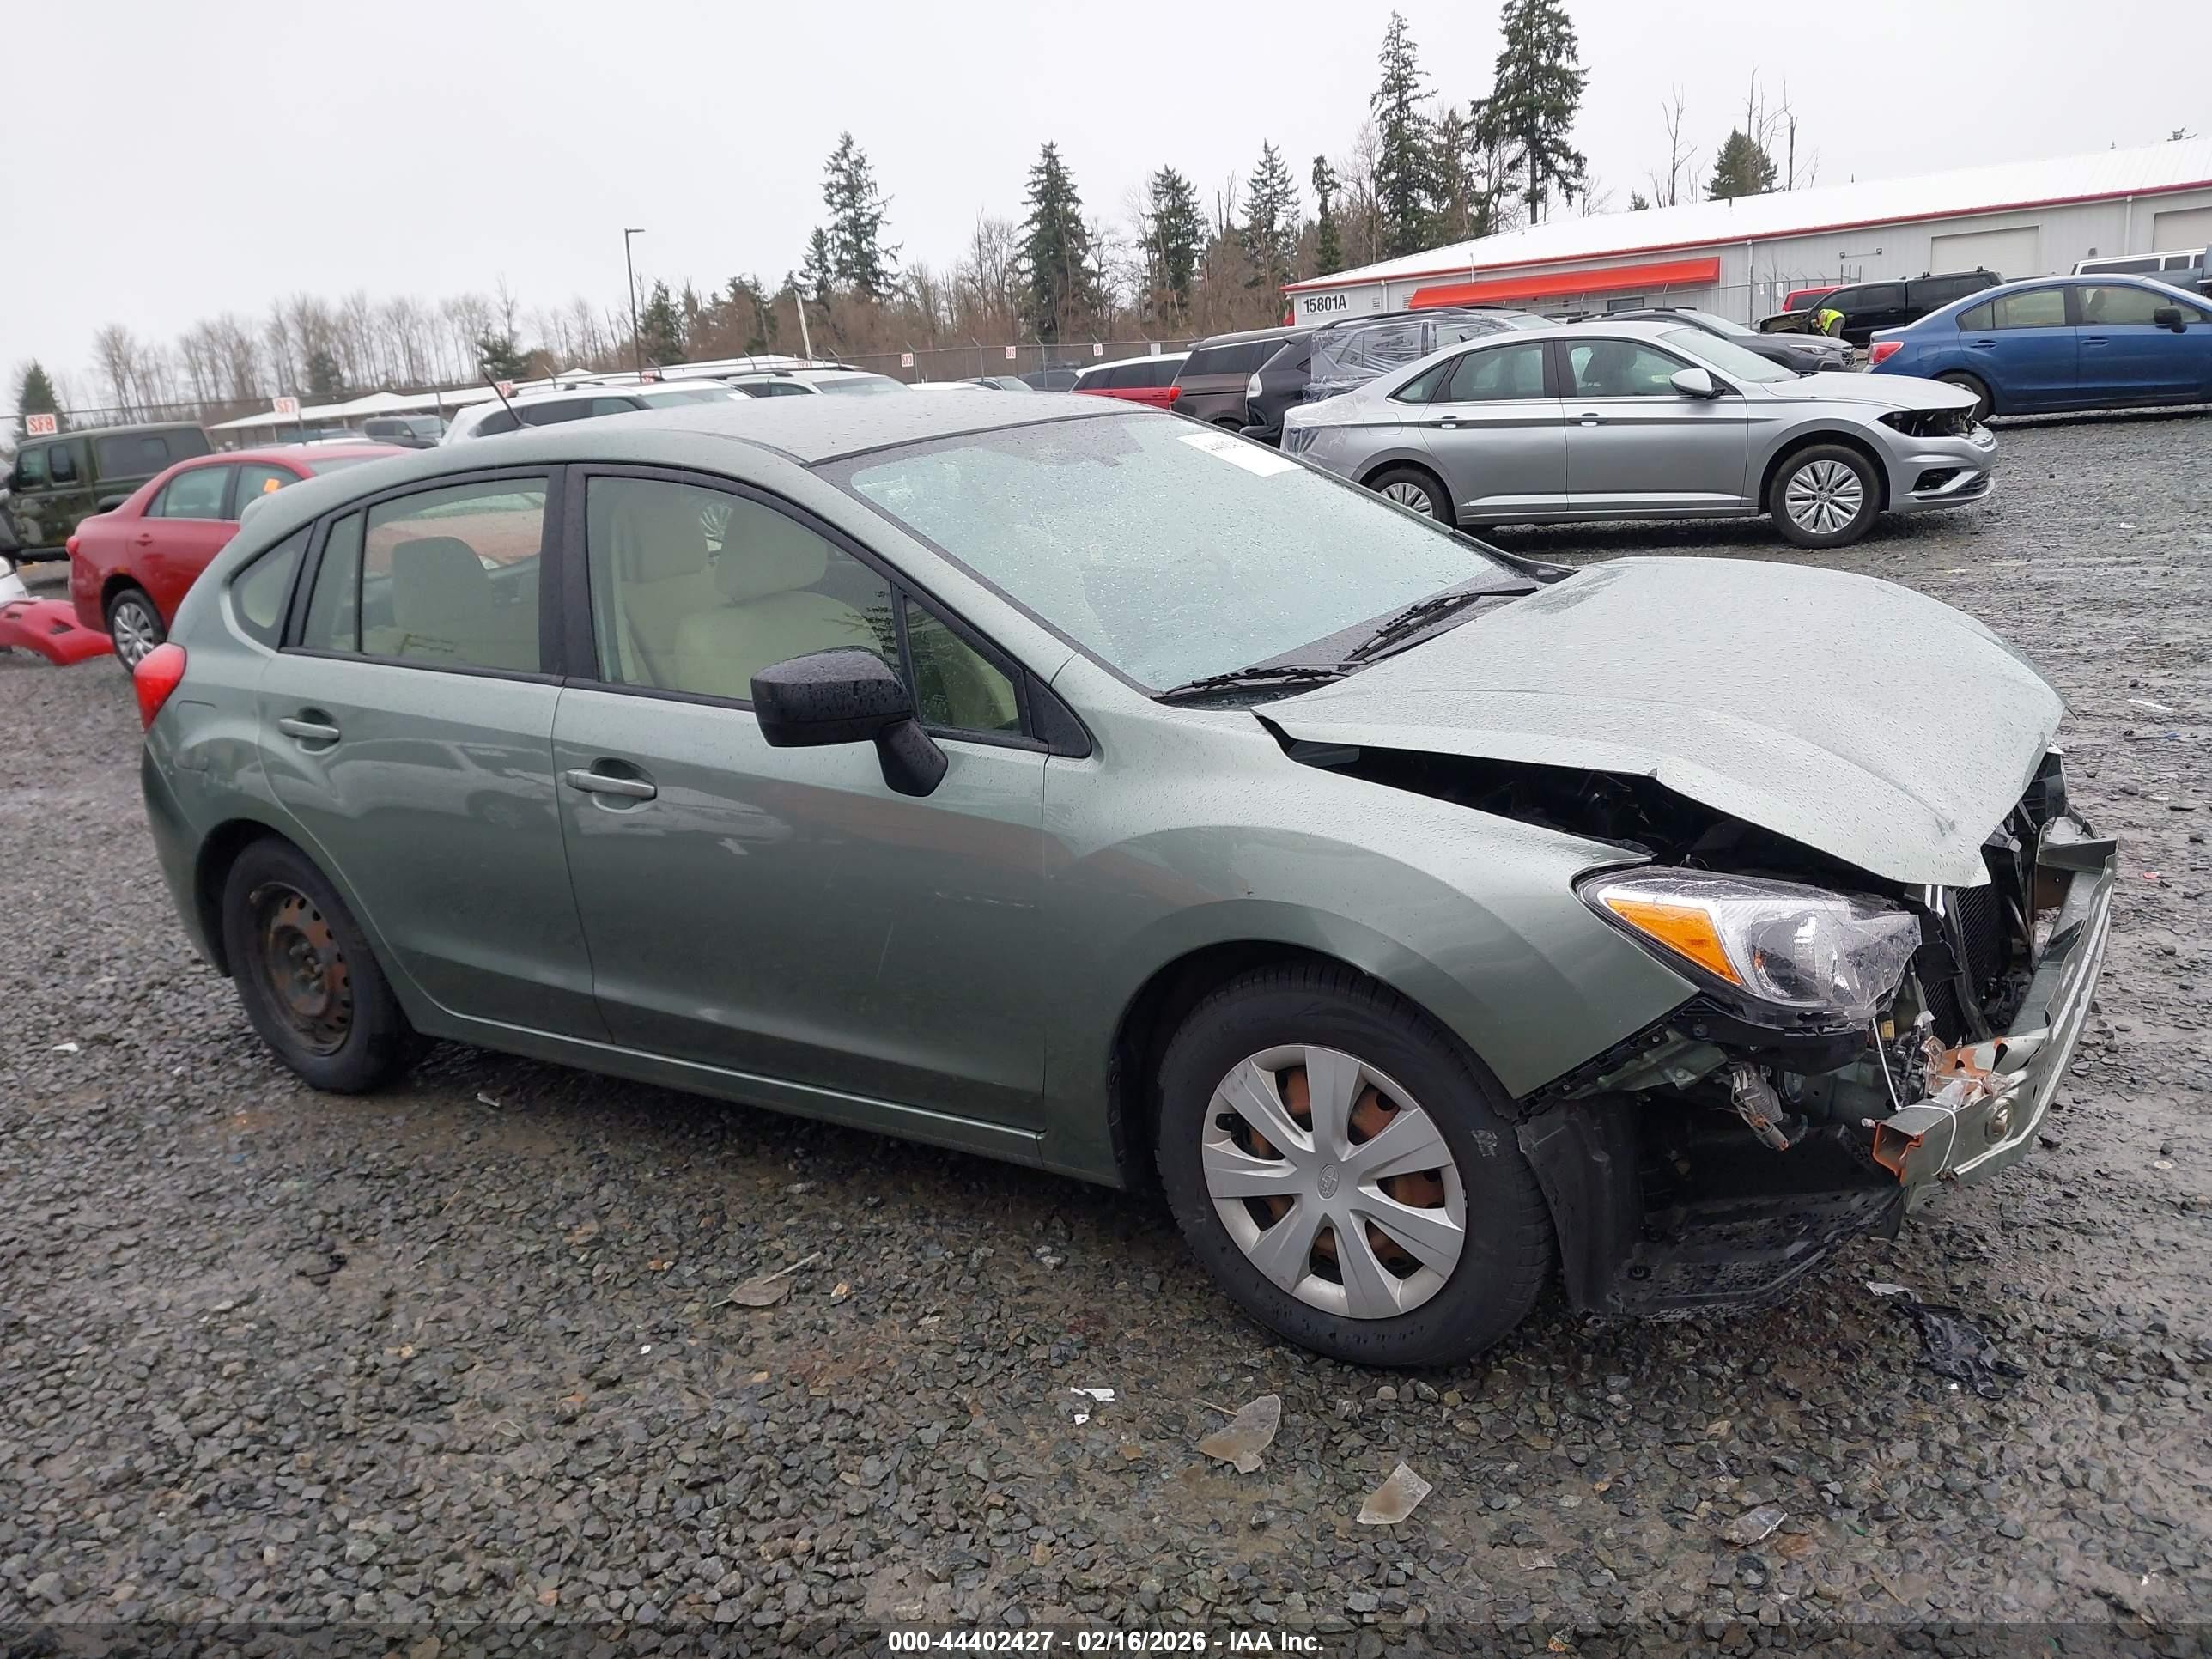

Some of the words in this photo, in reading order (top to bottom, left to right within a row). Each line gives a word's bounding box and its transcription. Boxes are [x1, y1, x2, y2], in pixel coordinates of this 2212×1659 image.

[1304, 295, 1346, 313] 15801A
[902, 355, 913, 366] SF3
[1006, 348, 1015, 358] SF2
[275, 398, 295, 414] SF7
[28, 416, 55, 433] SF8
